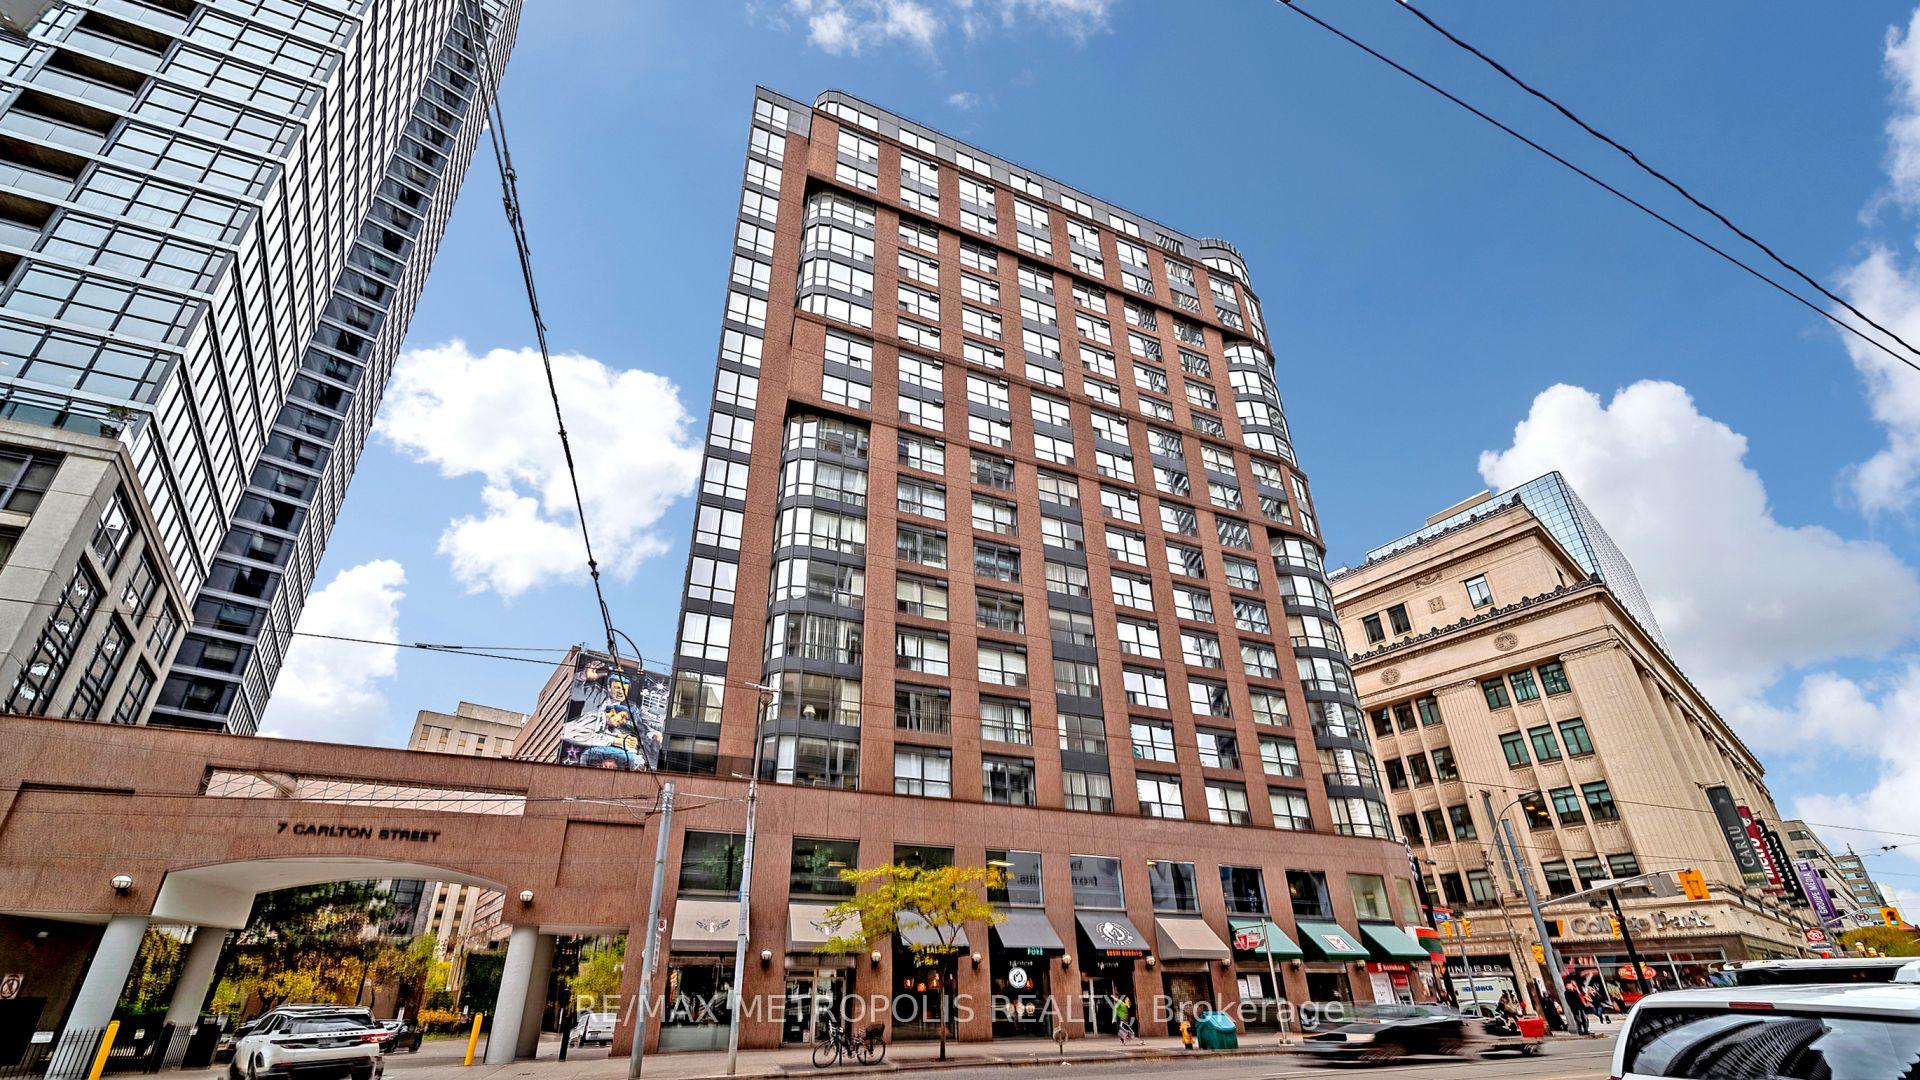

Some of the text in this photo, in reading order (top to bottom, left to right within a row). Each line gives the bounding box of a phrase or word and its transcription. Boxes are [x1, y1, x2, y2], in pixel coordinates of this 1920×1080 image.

[276, 822, 441, 843] 7 CARLTON STREET
[1727, 824, 1755, 868] CARLU
[1650, 910, 1715, 931] Park
